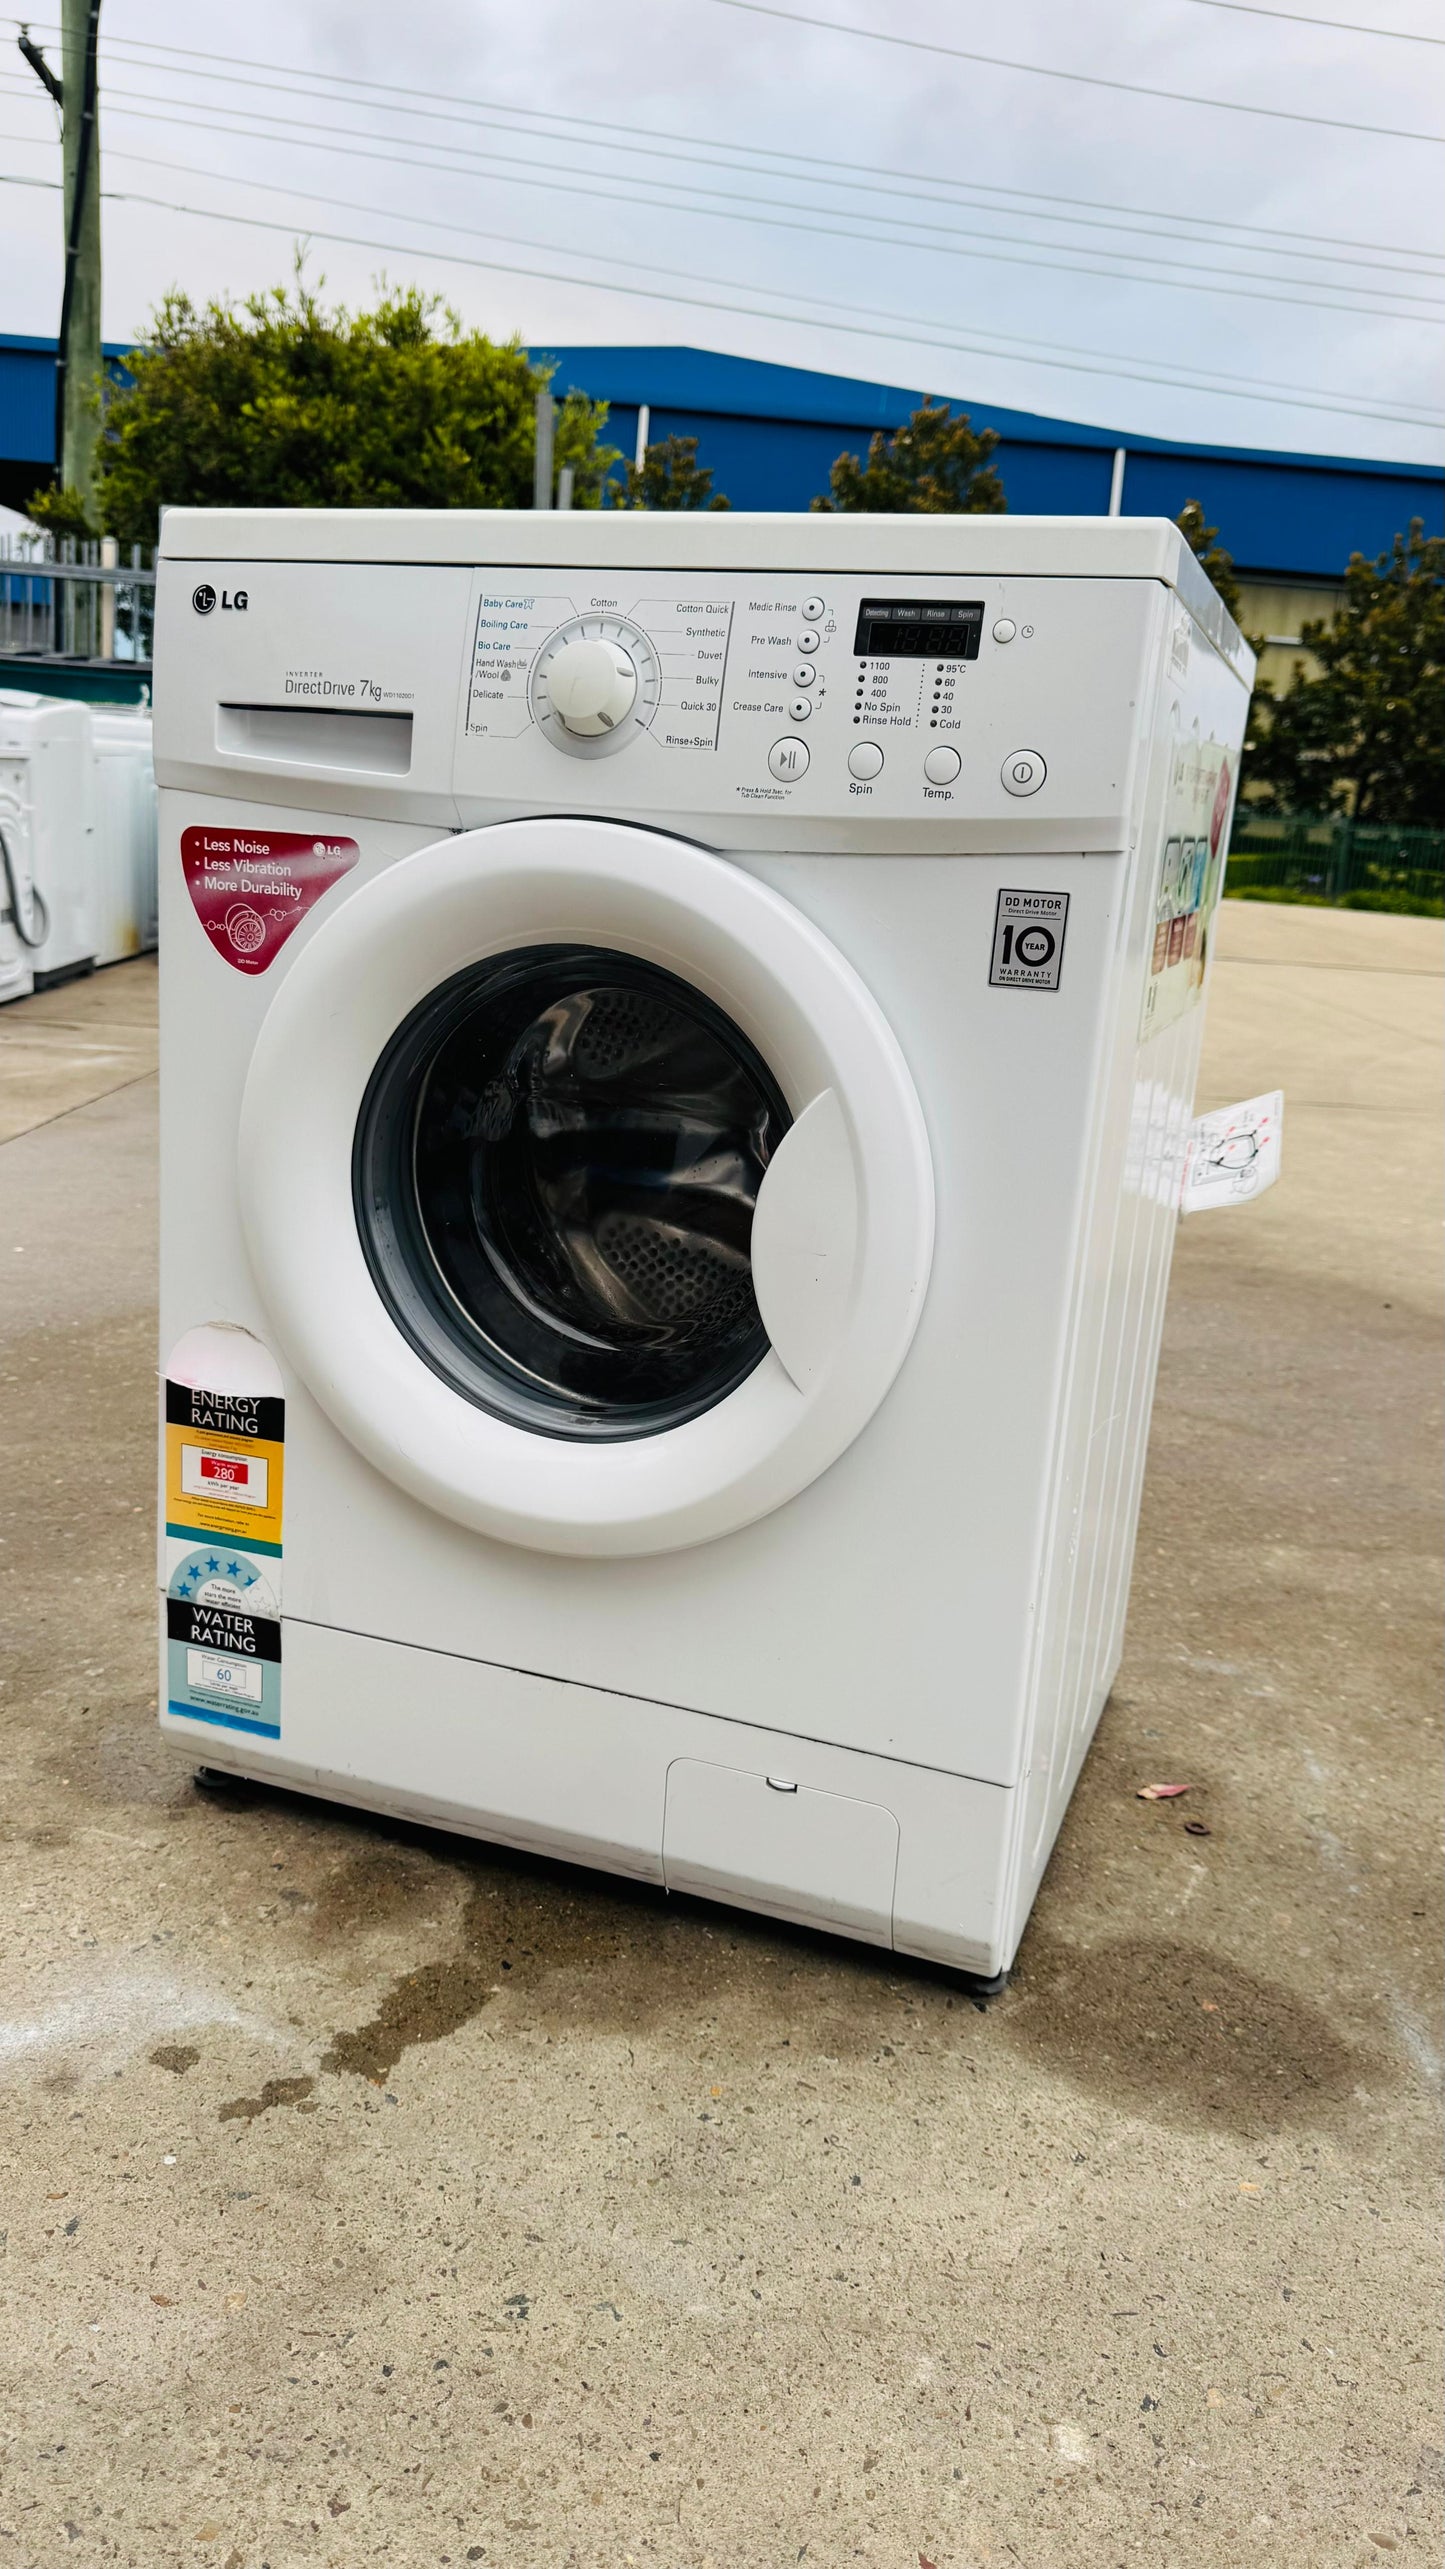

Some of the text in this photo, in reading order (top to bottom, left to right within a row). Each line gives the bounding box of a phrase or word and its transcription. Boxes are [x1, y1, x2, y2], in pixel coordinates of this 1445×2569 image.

[221, 590, 249, 610] LG
[483, 599, 523, 608] Baby Care
[590, 598, 618, 607] Cotton
[676, 604, 729, 614] Cotton Quick
[749, 602, 797, 612] Medic Rinse
[865, 609, 889, 618] Detecting
[897, 609, 916, 617] Wash
[927, 610, 945, 618] Rinse
[958, 610, 974, 619] Spin
[481, 620, 528, 630] Boiling Care
[686, 628, 726, 638] Synthetic
[478, 641, 511, 650] Bio Care
[751, 635, 792, 646] Pre Wash
[697, 650, 723, 660] Duvet
[476, 659, 516, 668] Hand Wash
[870, 662, 890, 670] 1100
[475, 670, 499, 679] /Wool
[748, 669, 788, 679] Intensive
[696, 675, 719, 686] Bulky
[872, 676, 889, 684] 800
[944, 679, 955, 687] 60
[473, 689, 504, 699] Delicate
[870, 689, 887, 698] 400
[943, 692, 954, 701] 40
[680, 701, 717, 711] Quick 30
[733, 701, 784, 712] Crease Care
[864, 702, 901, 713] No Spin
[941, 705, 952, 714] 30
[862, 715, 912, 726] Rinse Hold
[939, 719, 961, 729] Cold
[470, 723, 488, 733] Spin
[666, 735, 713, 747] Rinse+Spin
[849, 783, 873, 795] Spin
[922, 787, 954, 800] Temp.
[203, 837, 270, 854] Less Noise
[326, 845, 341, 855] LG
[204, 857, 291, 876] Less Vibration
[204, 876, 302, 900] More Durability
[1005, 897, 1062, 909] DD MOTOR
[1002, 925, 1055, 967] 10
[1025, 942, 1045, 951] YEAR
[1000, 968, 1051, 978] WARRANTY
[191, 1389, 260, 1415] ENERGY
[191, 1408, 258, 1434] RATING
[201, 1449, 217, 1457] Energy
[213, 1466, 235, 1481] 280
[193, 1606, 254, 1635] WATER
[191, 1625, 256, 1652] RATING
[217, 1668, 232, 1681] 60
